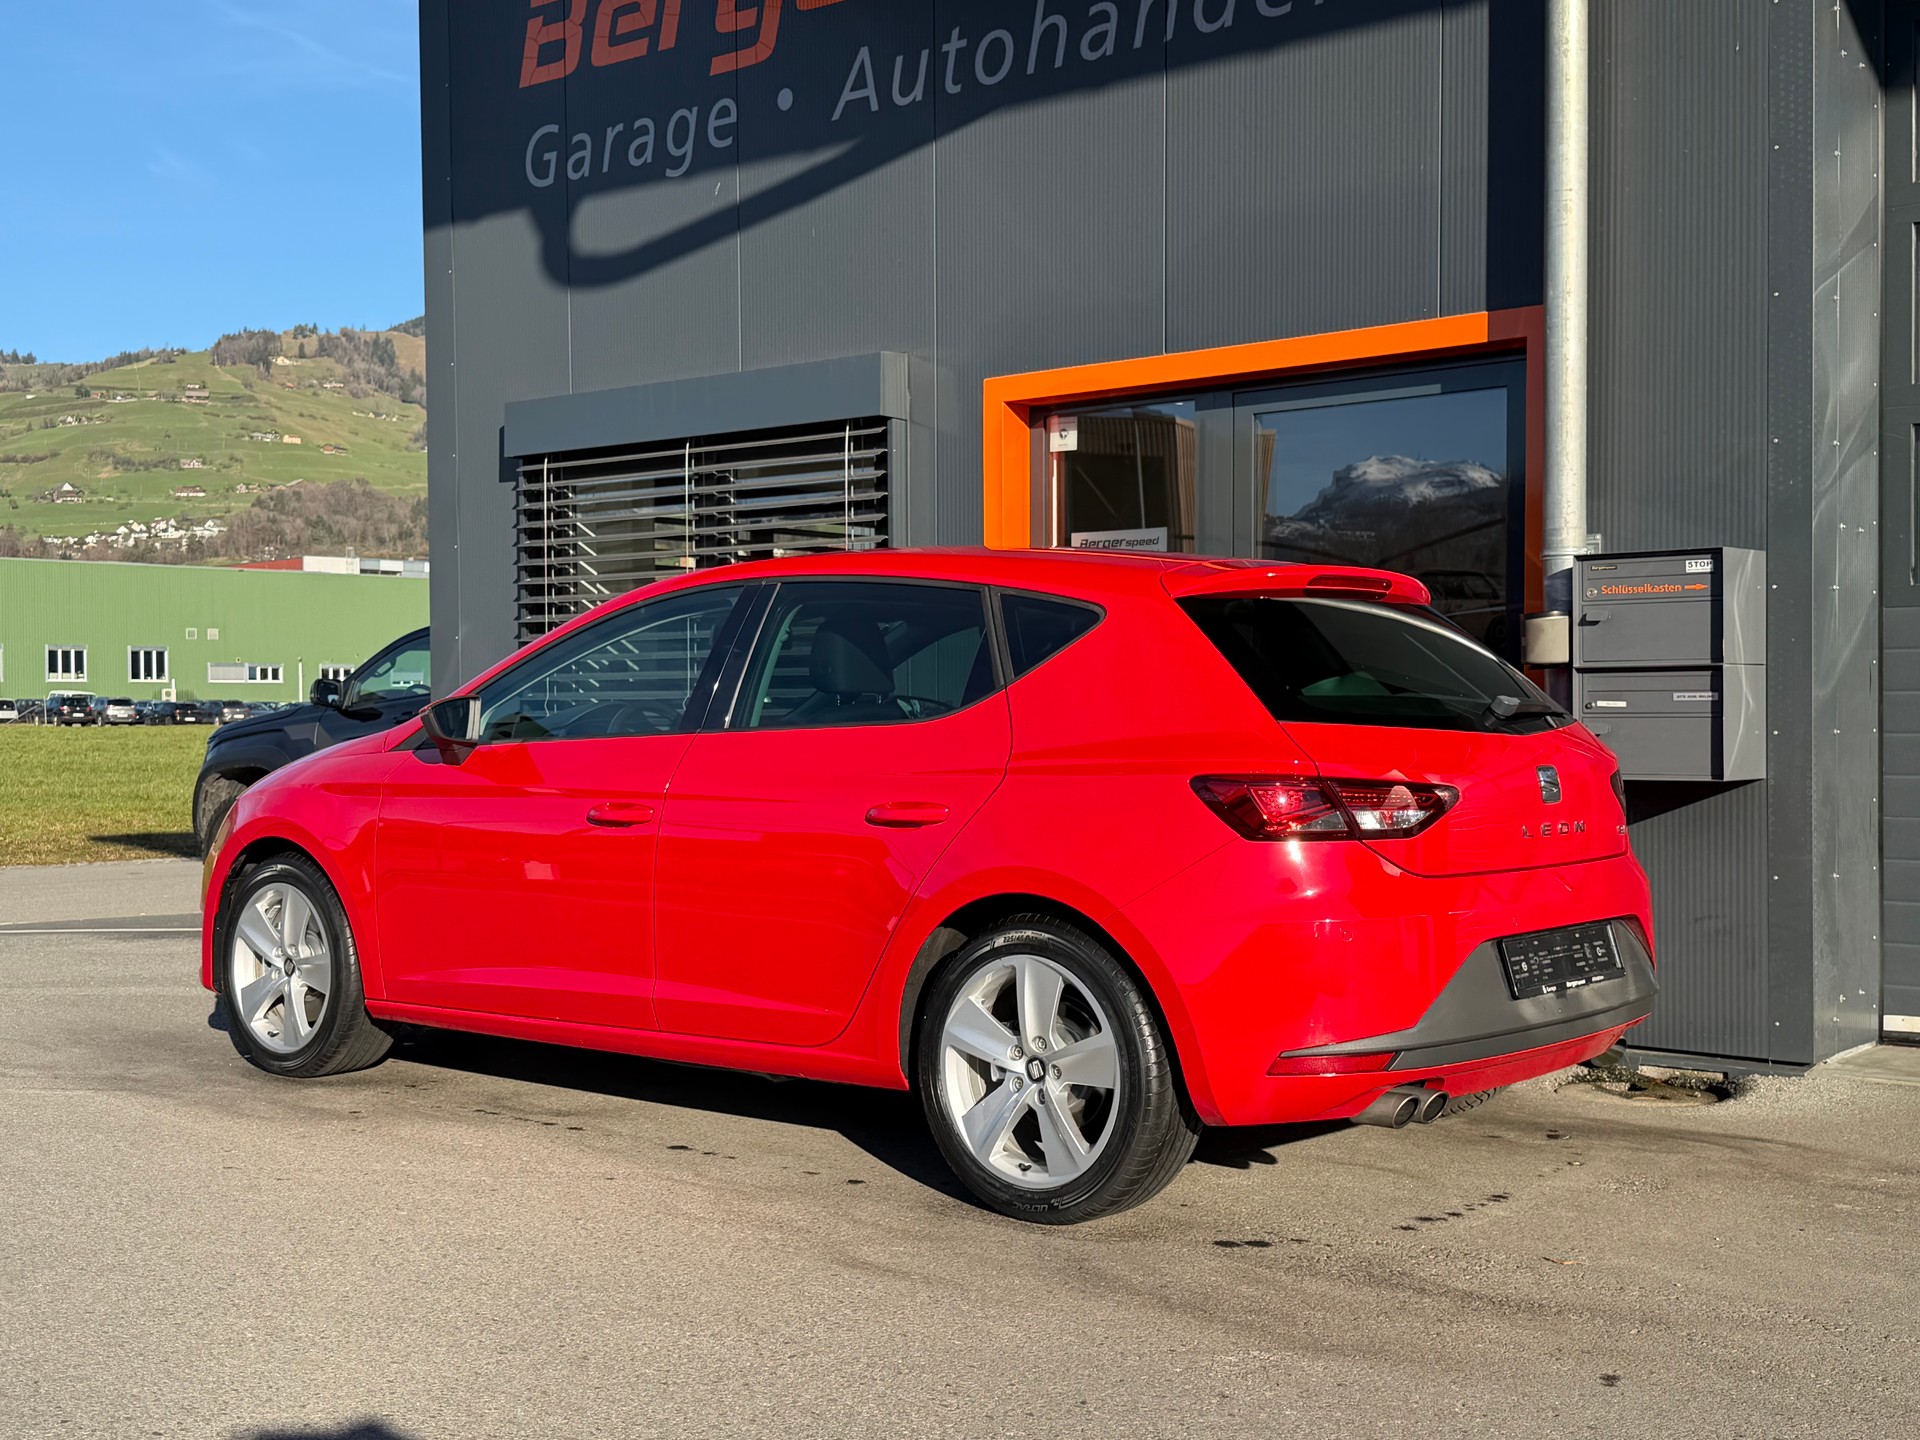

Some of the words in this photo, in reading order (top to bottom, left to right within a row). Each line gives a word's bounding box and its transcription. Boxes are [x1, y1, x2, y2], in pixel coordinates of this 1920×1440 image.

[519, 0, 847, 88] Berg
[525, 98, 738, 188] Garage
[831, 0, 1326, 121] Autohan
[1687, 560, 1713, 569] STOP
[1601, 583, 1683, 595] Schlüsselkasten
[1522, 821, 1586, 839] LEON
